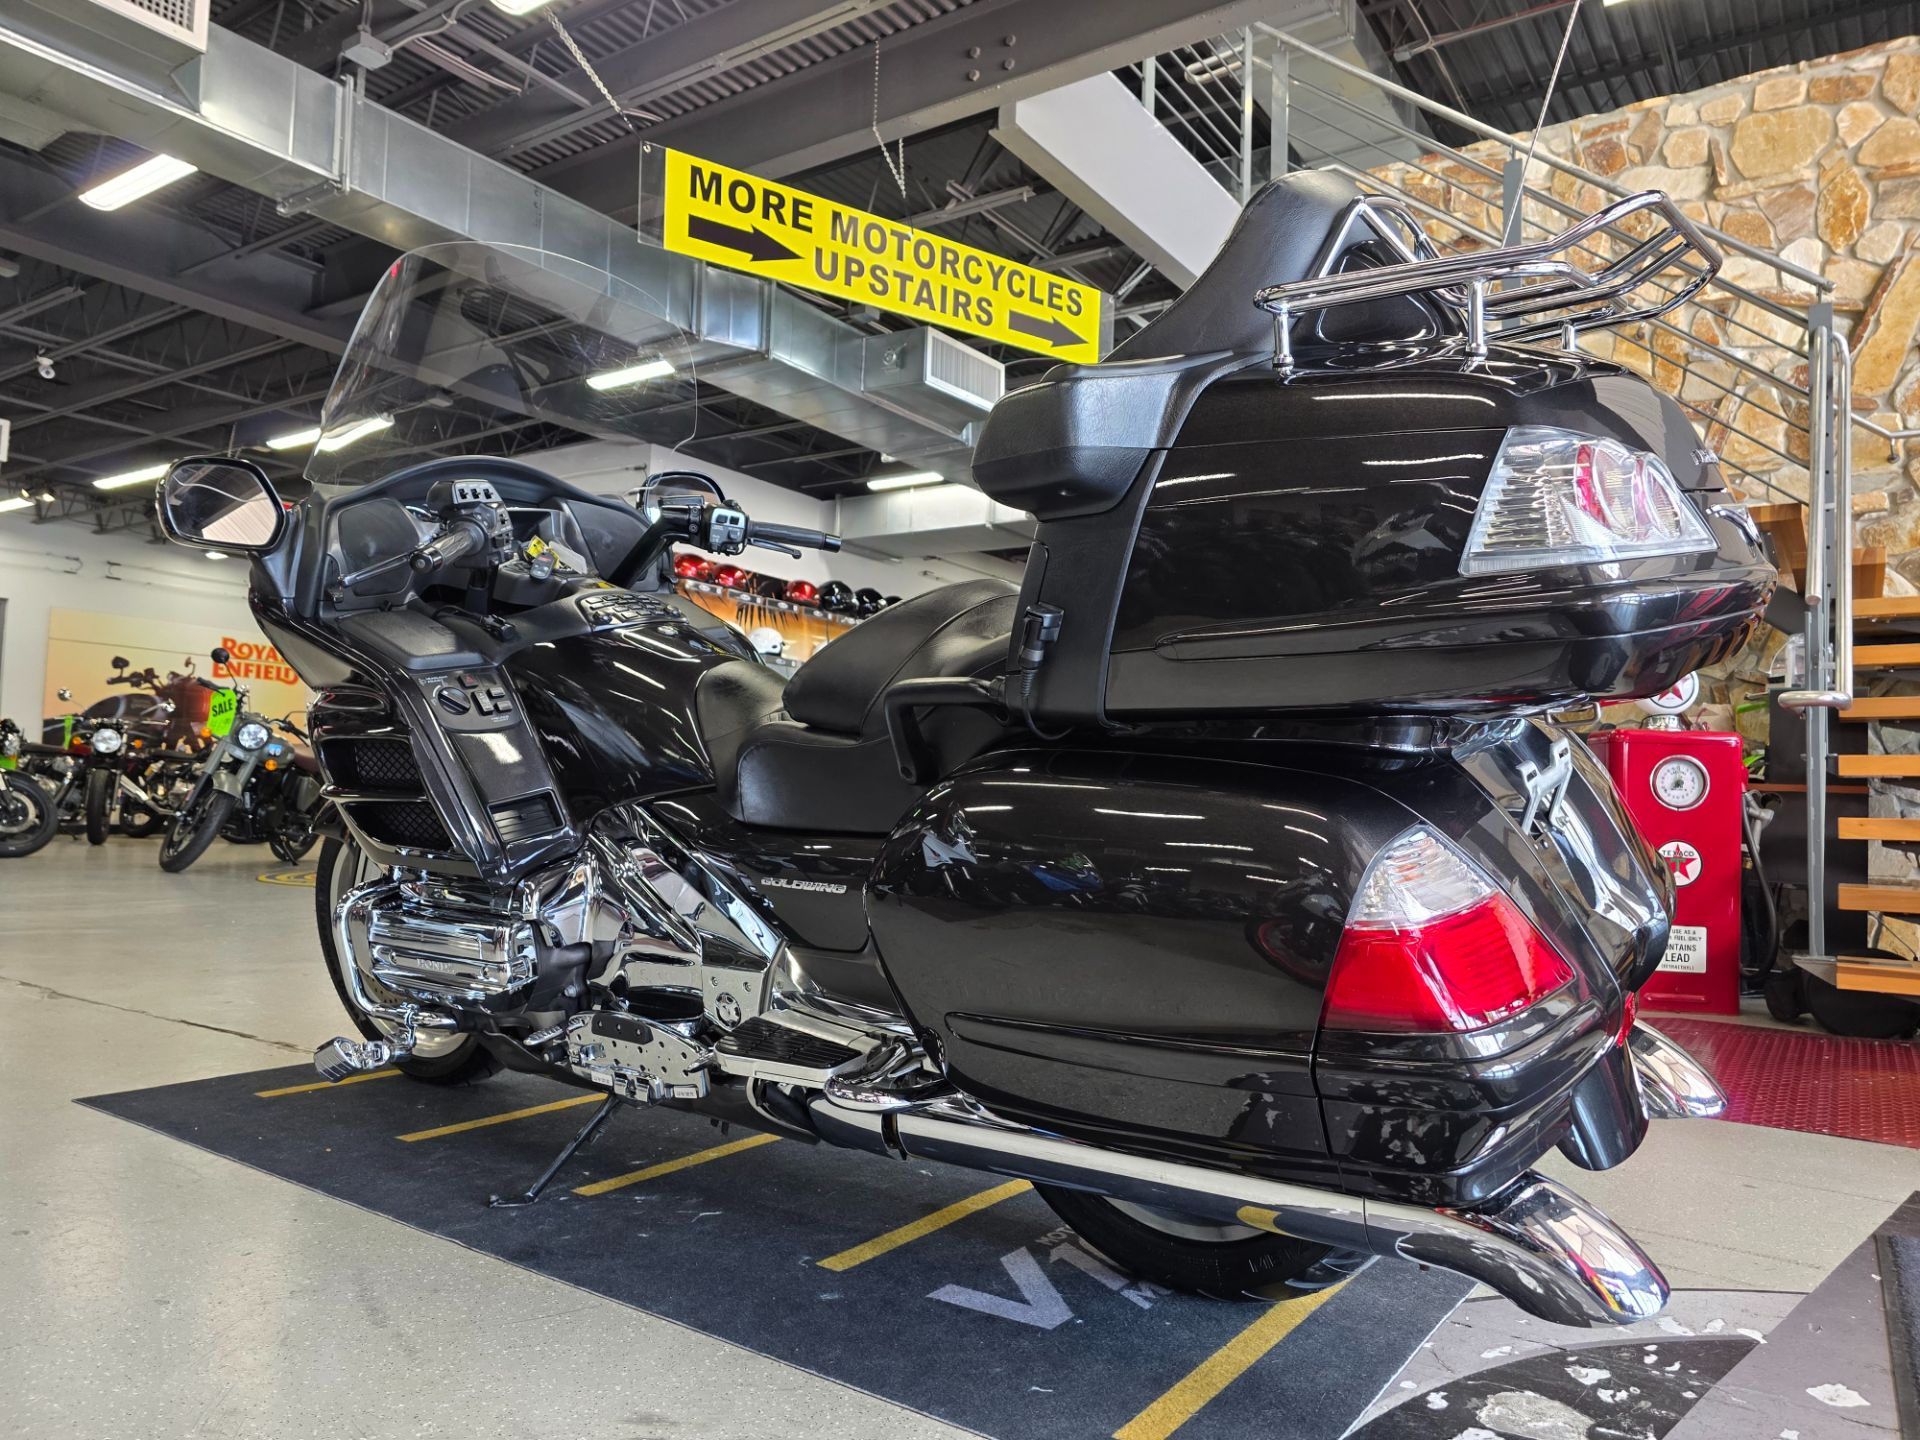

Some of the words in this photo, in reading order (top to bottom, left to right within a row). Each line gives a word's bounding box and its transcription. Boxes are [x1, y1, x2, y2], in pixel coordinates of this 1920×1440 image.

[690, 165, 813, 234] MORE
[831, 210, 1083, 317] MOTORCYCLES
[814, 246, 993, 326] UPSTAIRS
[212, 661, 299, 685] ENFIELD
[212, 699, 234, 717] SALE
[761, 877, 847, 894] GOLDWING
[1665, 953, 1690, 962] LEAD
